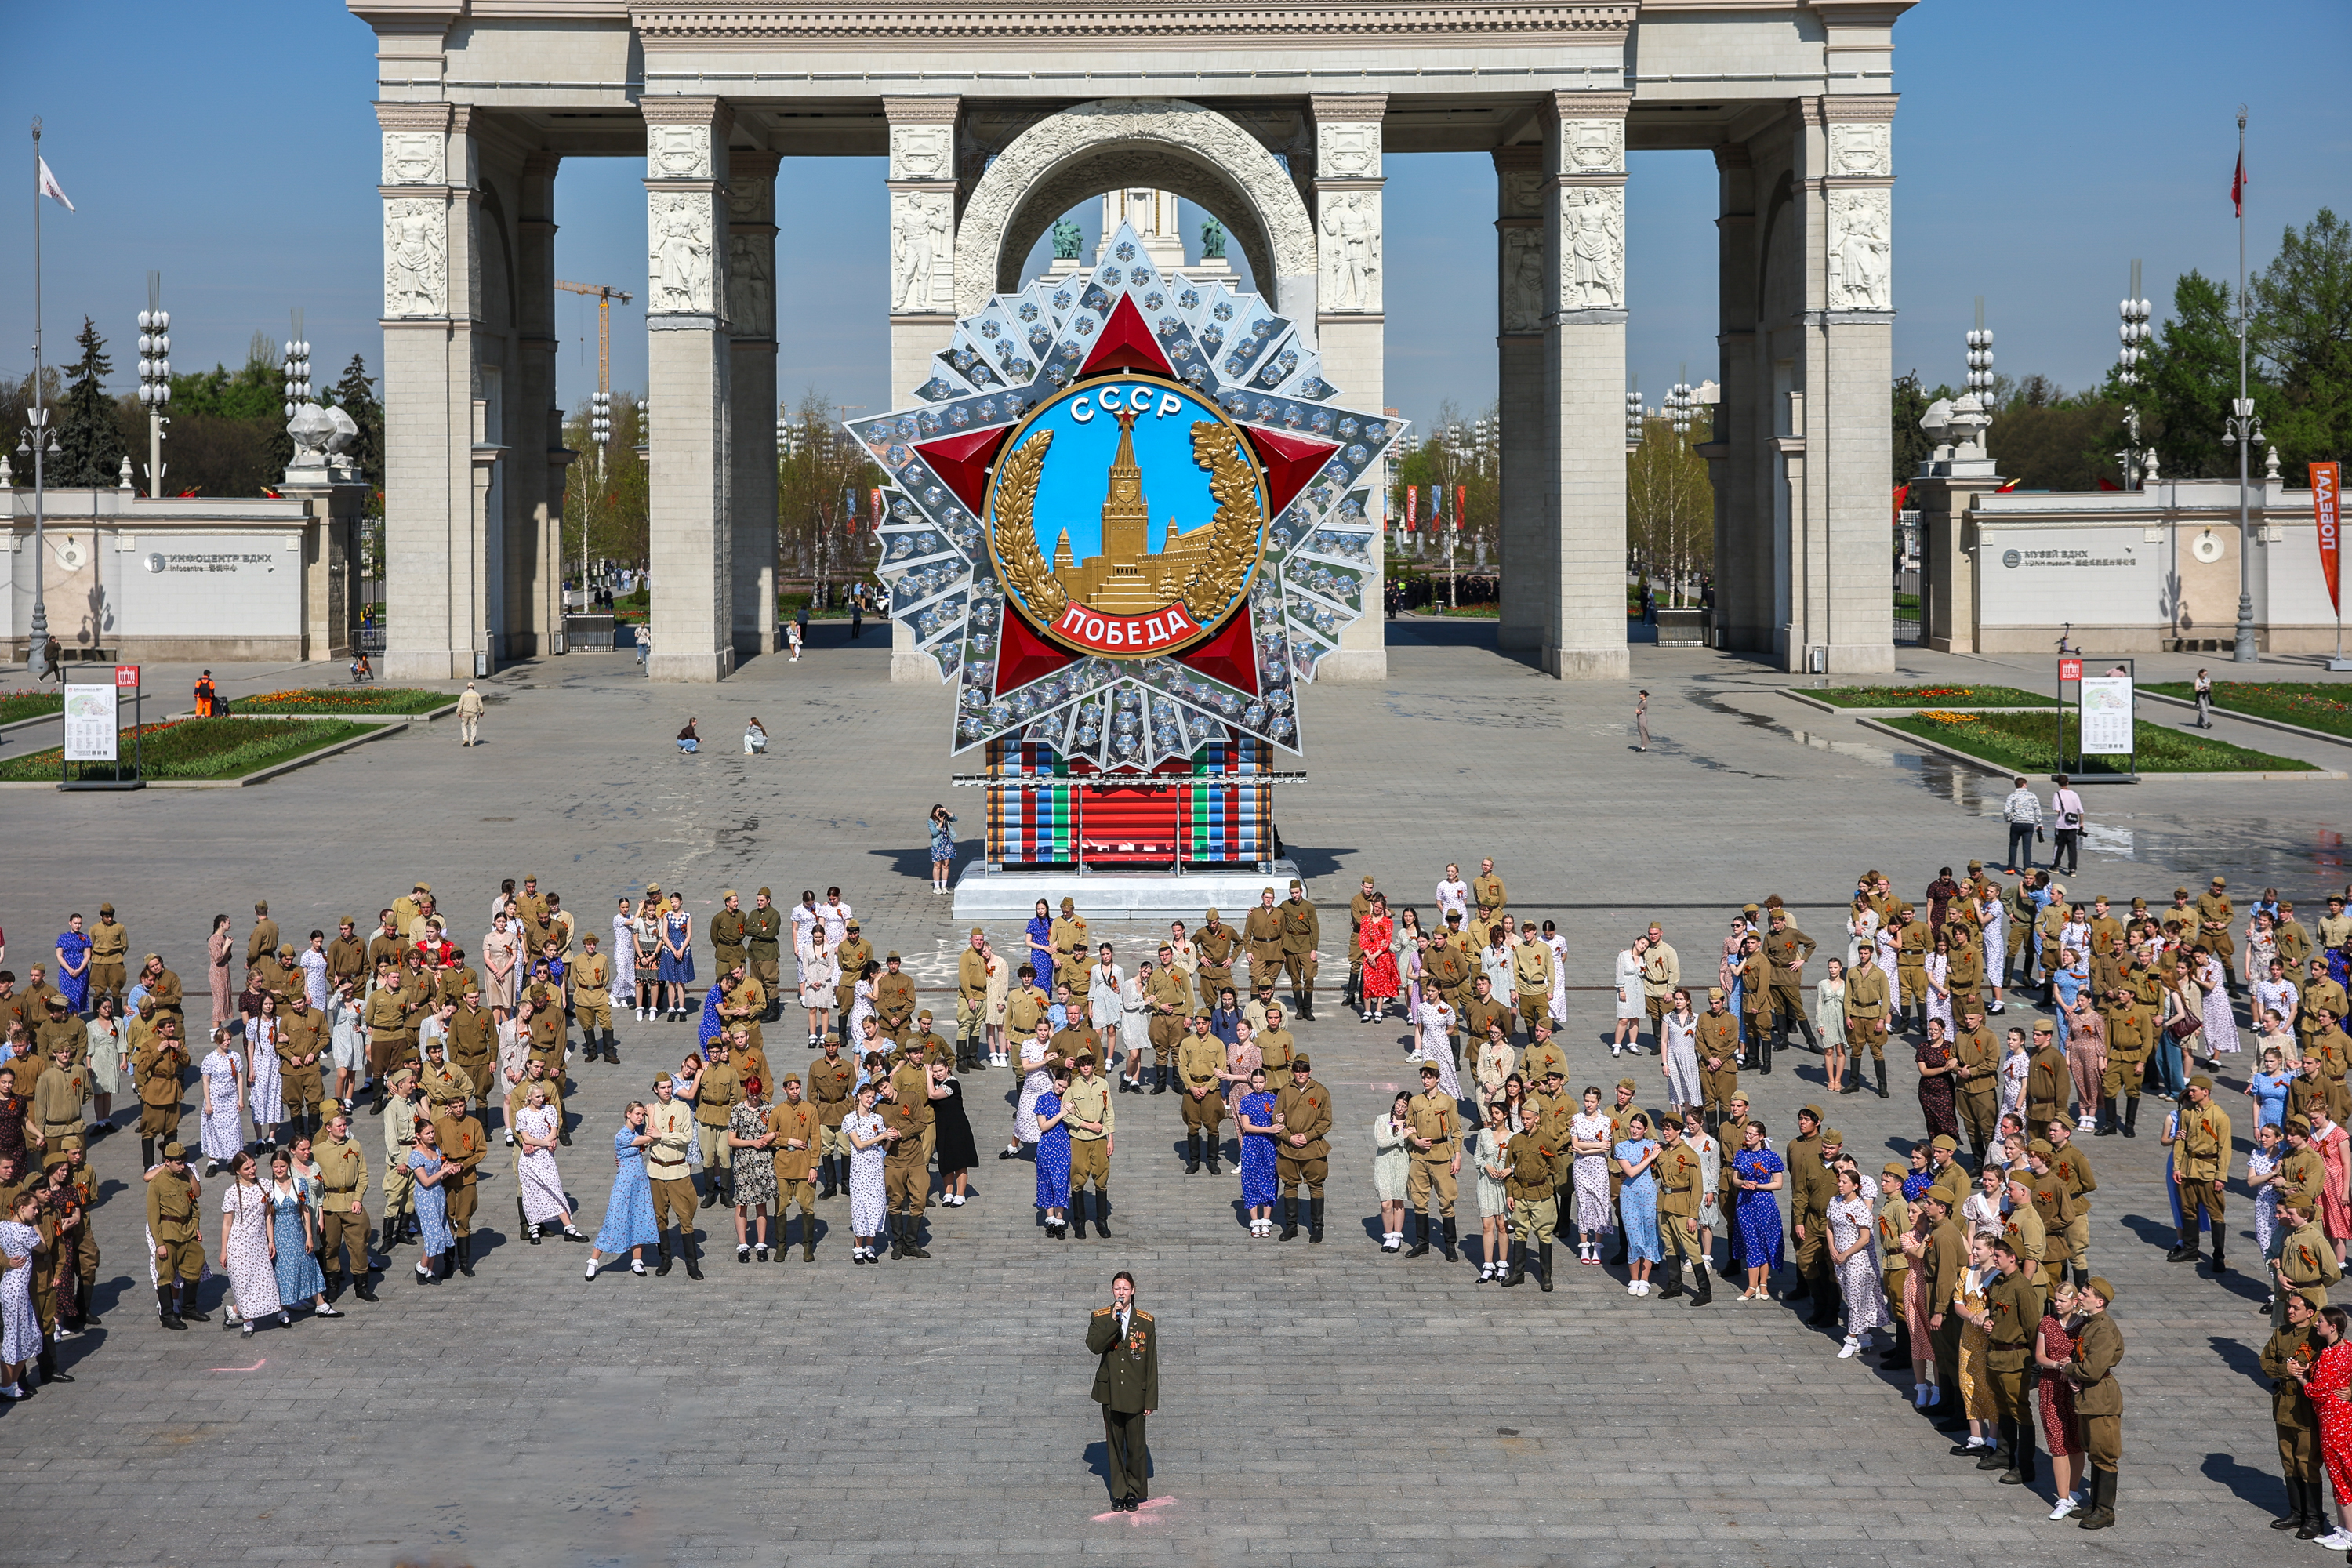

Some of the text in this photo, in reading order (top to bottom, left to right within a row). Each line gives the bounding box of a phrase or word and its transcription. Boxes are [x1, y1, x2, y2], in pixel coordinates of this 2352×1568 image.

[1070, 386, 1182, 422] СССР
[170, 554, 272, 564] ИНФОЦЕНТР ВДНХ
[2024, 550, 2088, 559] МУЗЕЙ ВДНХ
[1062, 608, 1189, 645] ПОБЕДА
